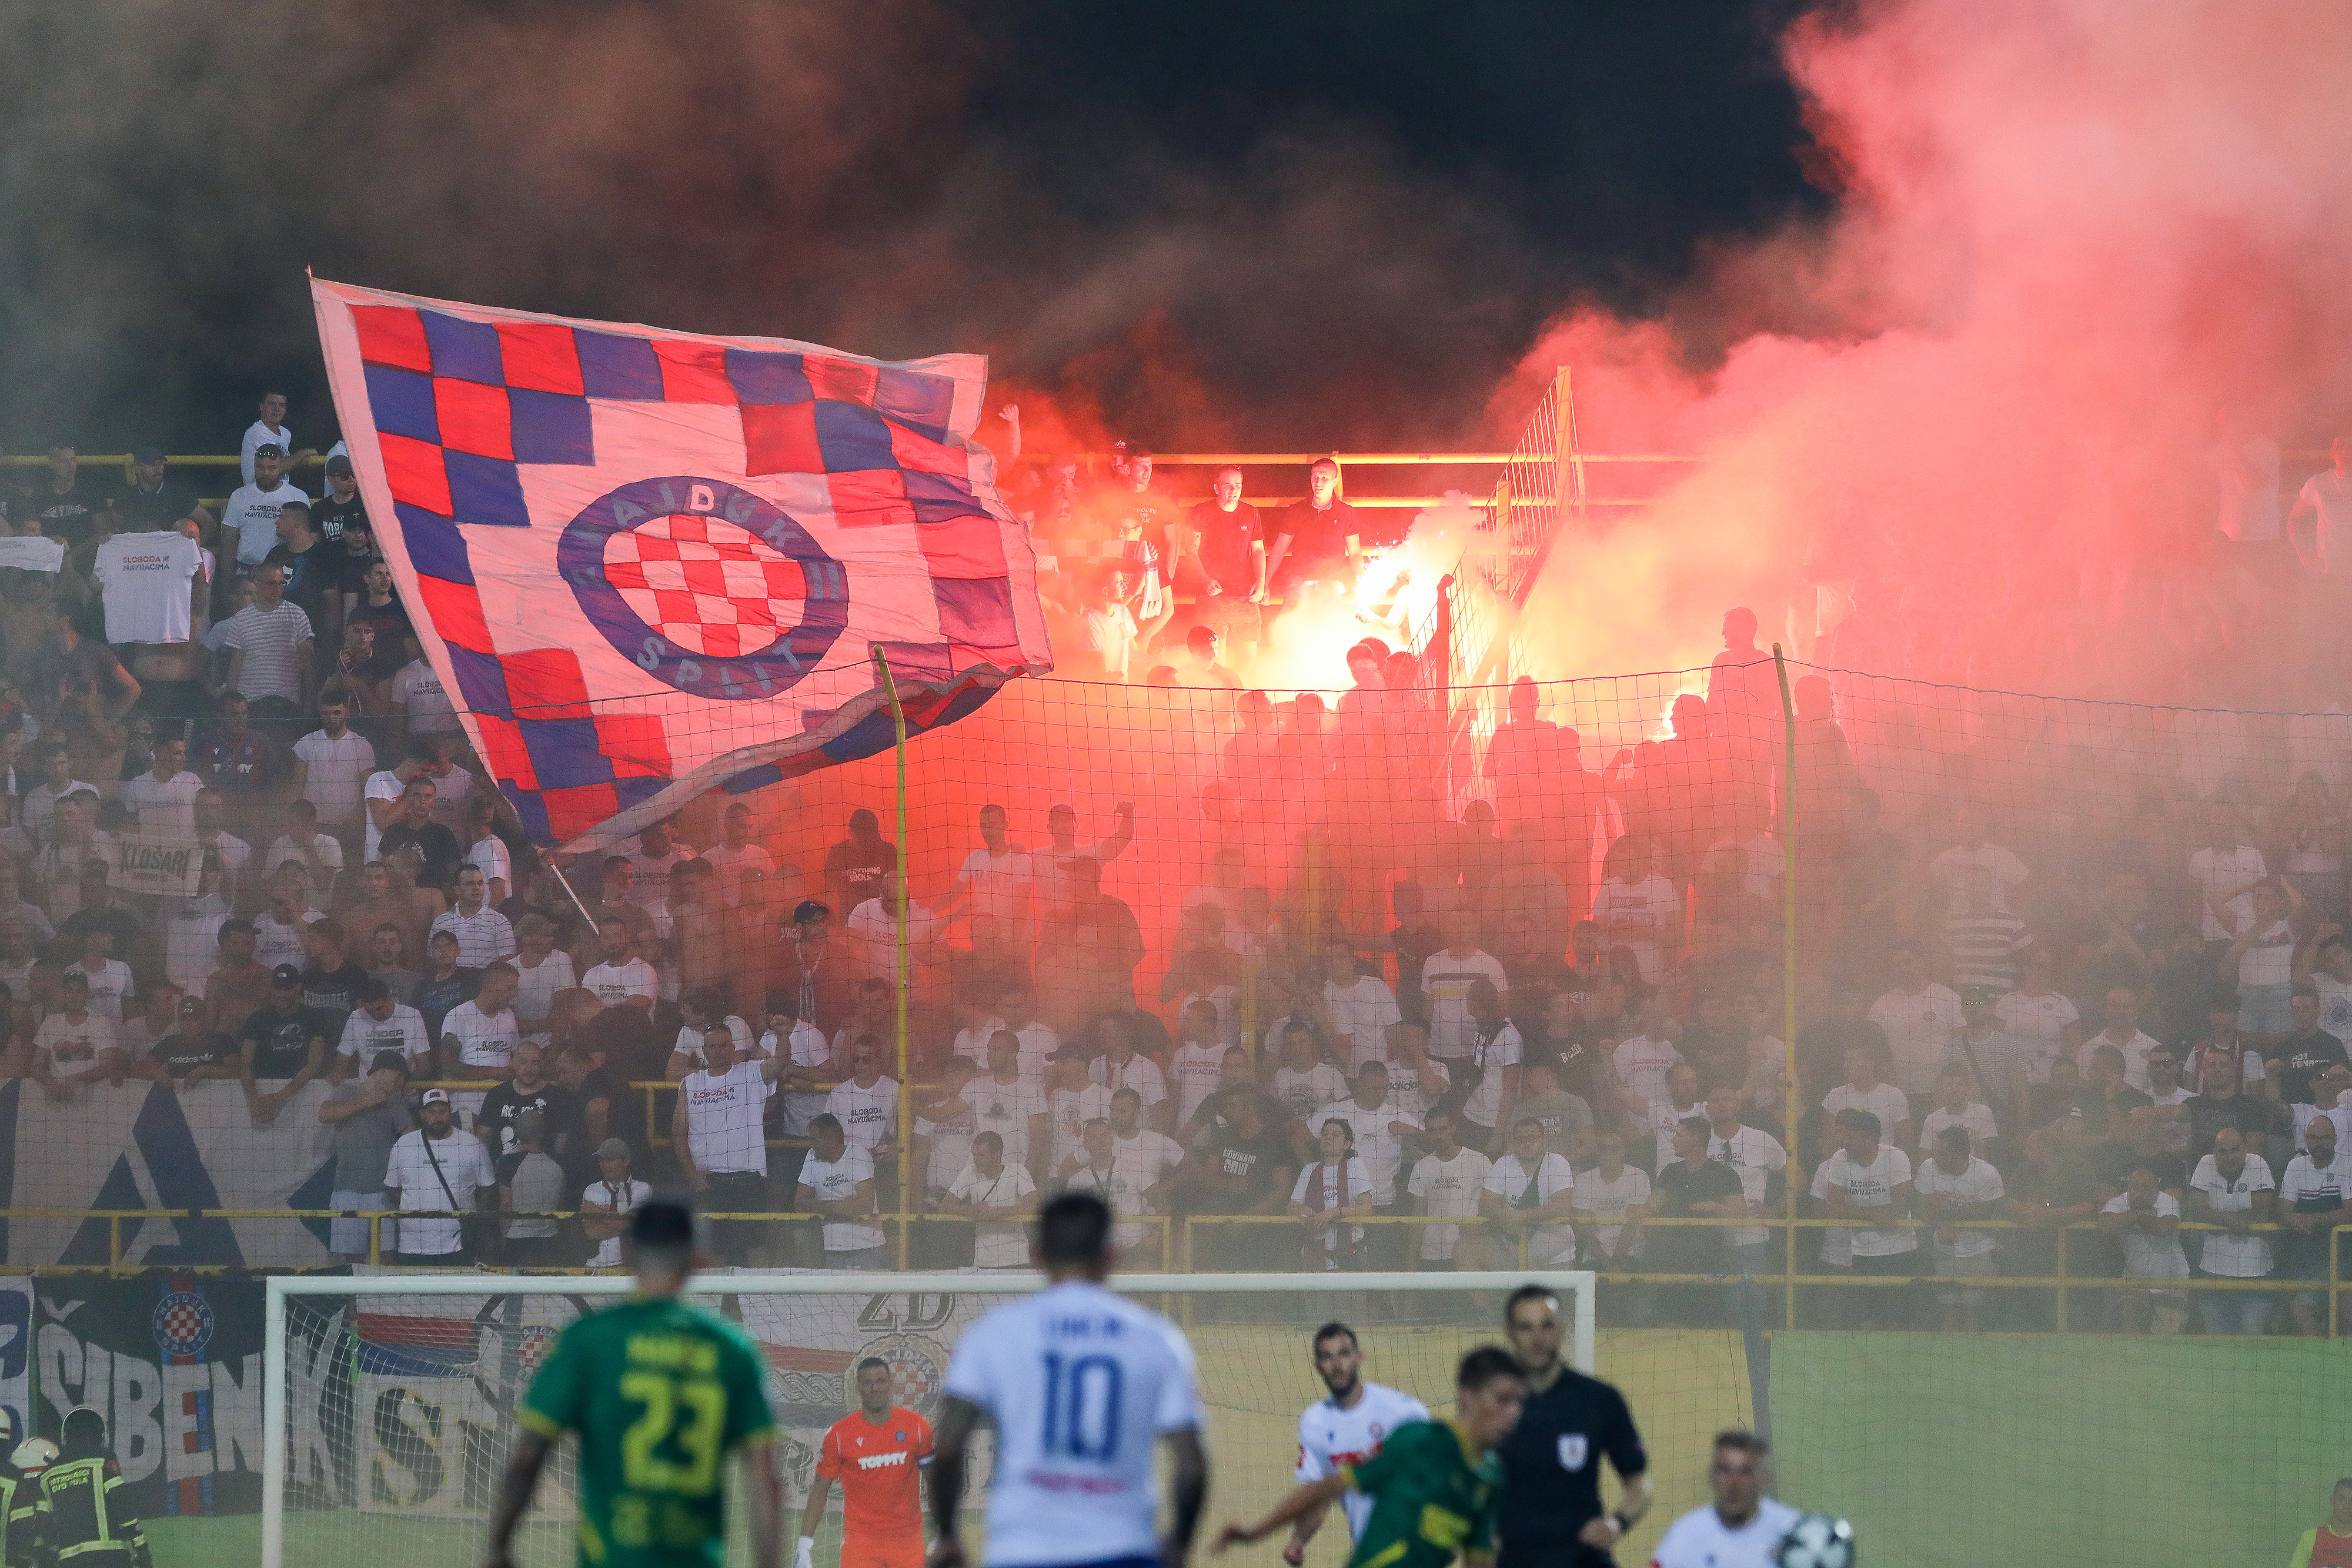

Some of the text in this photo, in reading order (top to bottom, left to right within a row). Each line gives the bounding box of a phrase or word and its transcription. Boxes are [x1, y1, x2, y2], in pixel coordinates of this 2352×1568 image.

[636, 636, 802, 697] SPLIT
[851, 1108, 883, 1116] SLOBODA
[158, 1294, 205, 1316] HAJDUK
[37, 1295, 345, 1506] ŠIBENK
[1042, 1350, 1124, 1462] 10
[619, 1372, 729, 1496] 23
[858, 1452, 907, 1470] TOMMY
